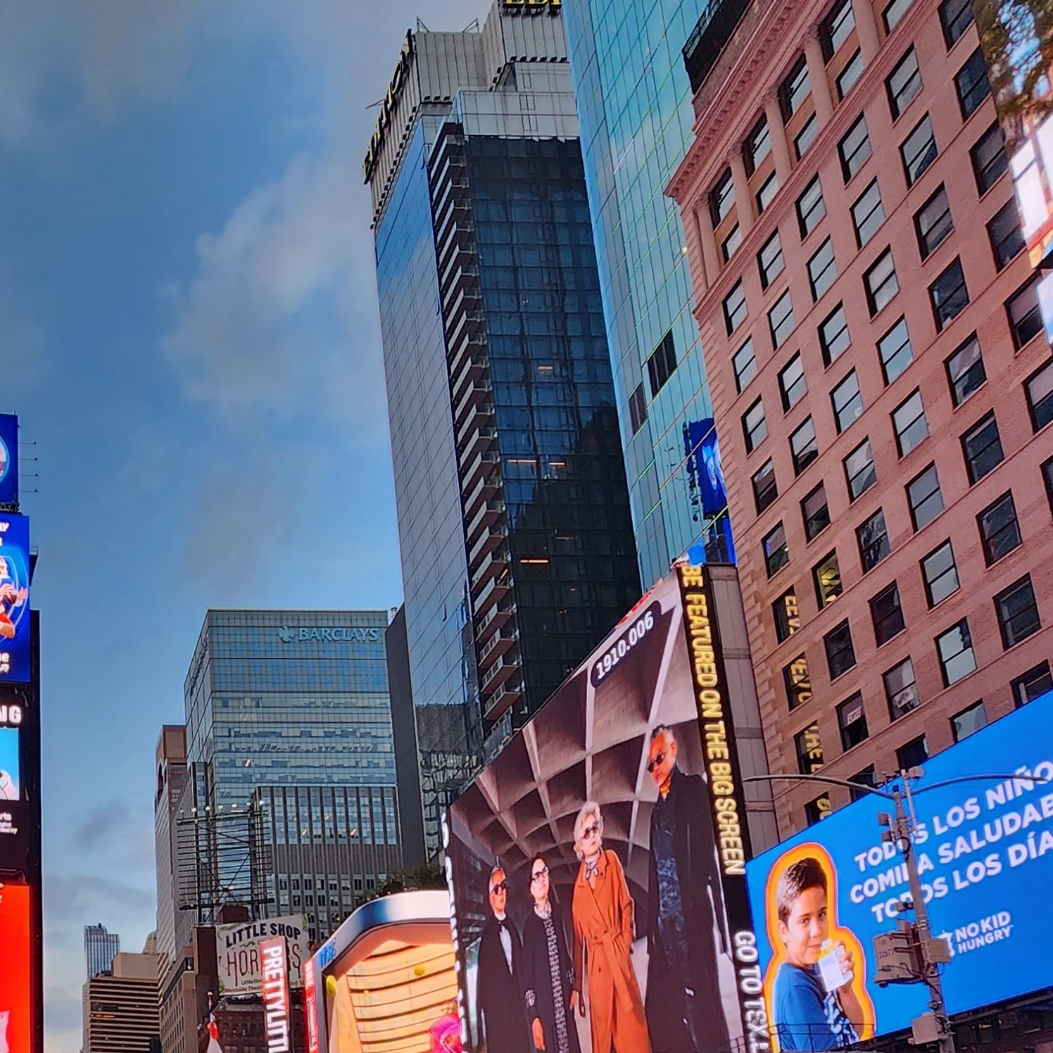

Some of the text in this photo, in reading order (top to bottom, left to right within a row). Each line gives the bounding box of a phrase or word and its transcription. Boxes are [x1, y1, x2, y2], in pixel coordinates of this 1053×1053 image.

[298, 628, 378, 641] BARCLAYS
[595, 609, 654, 680] 1910.006
[680, 565, 746, 876] BE FEATURED ON THE BIG SCREEN
[855, 823, 929, 872] TODS
[933, 798, 981, 835] LOS
[952, 853, 1002, 890] LOS
[226, 923, 301, 949] LITTLE SHOP
[956, 911, 1011, 940] NO KID
[958, 925, 1013, 955] HUNGRY
[227, 943, 301, 987] HORS
[734, 930, 762, 994] GO TO
